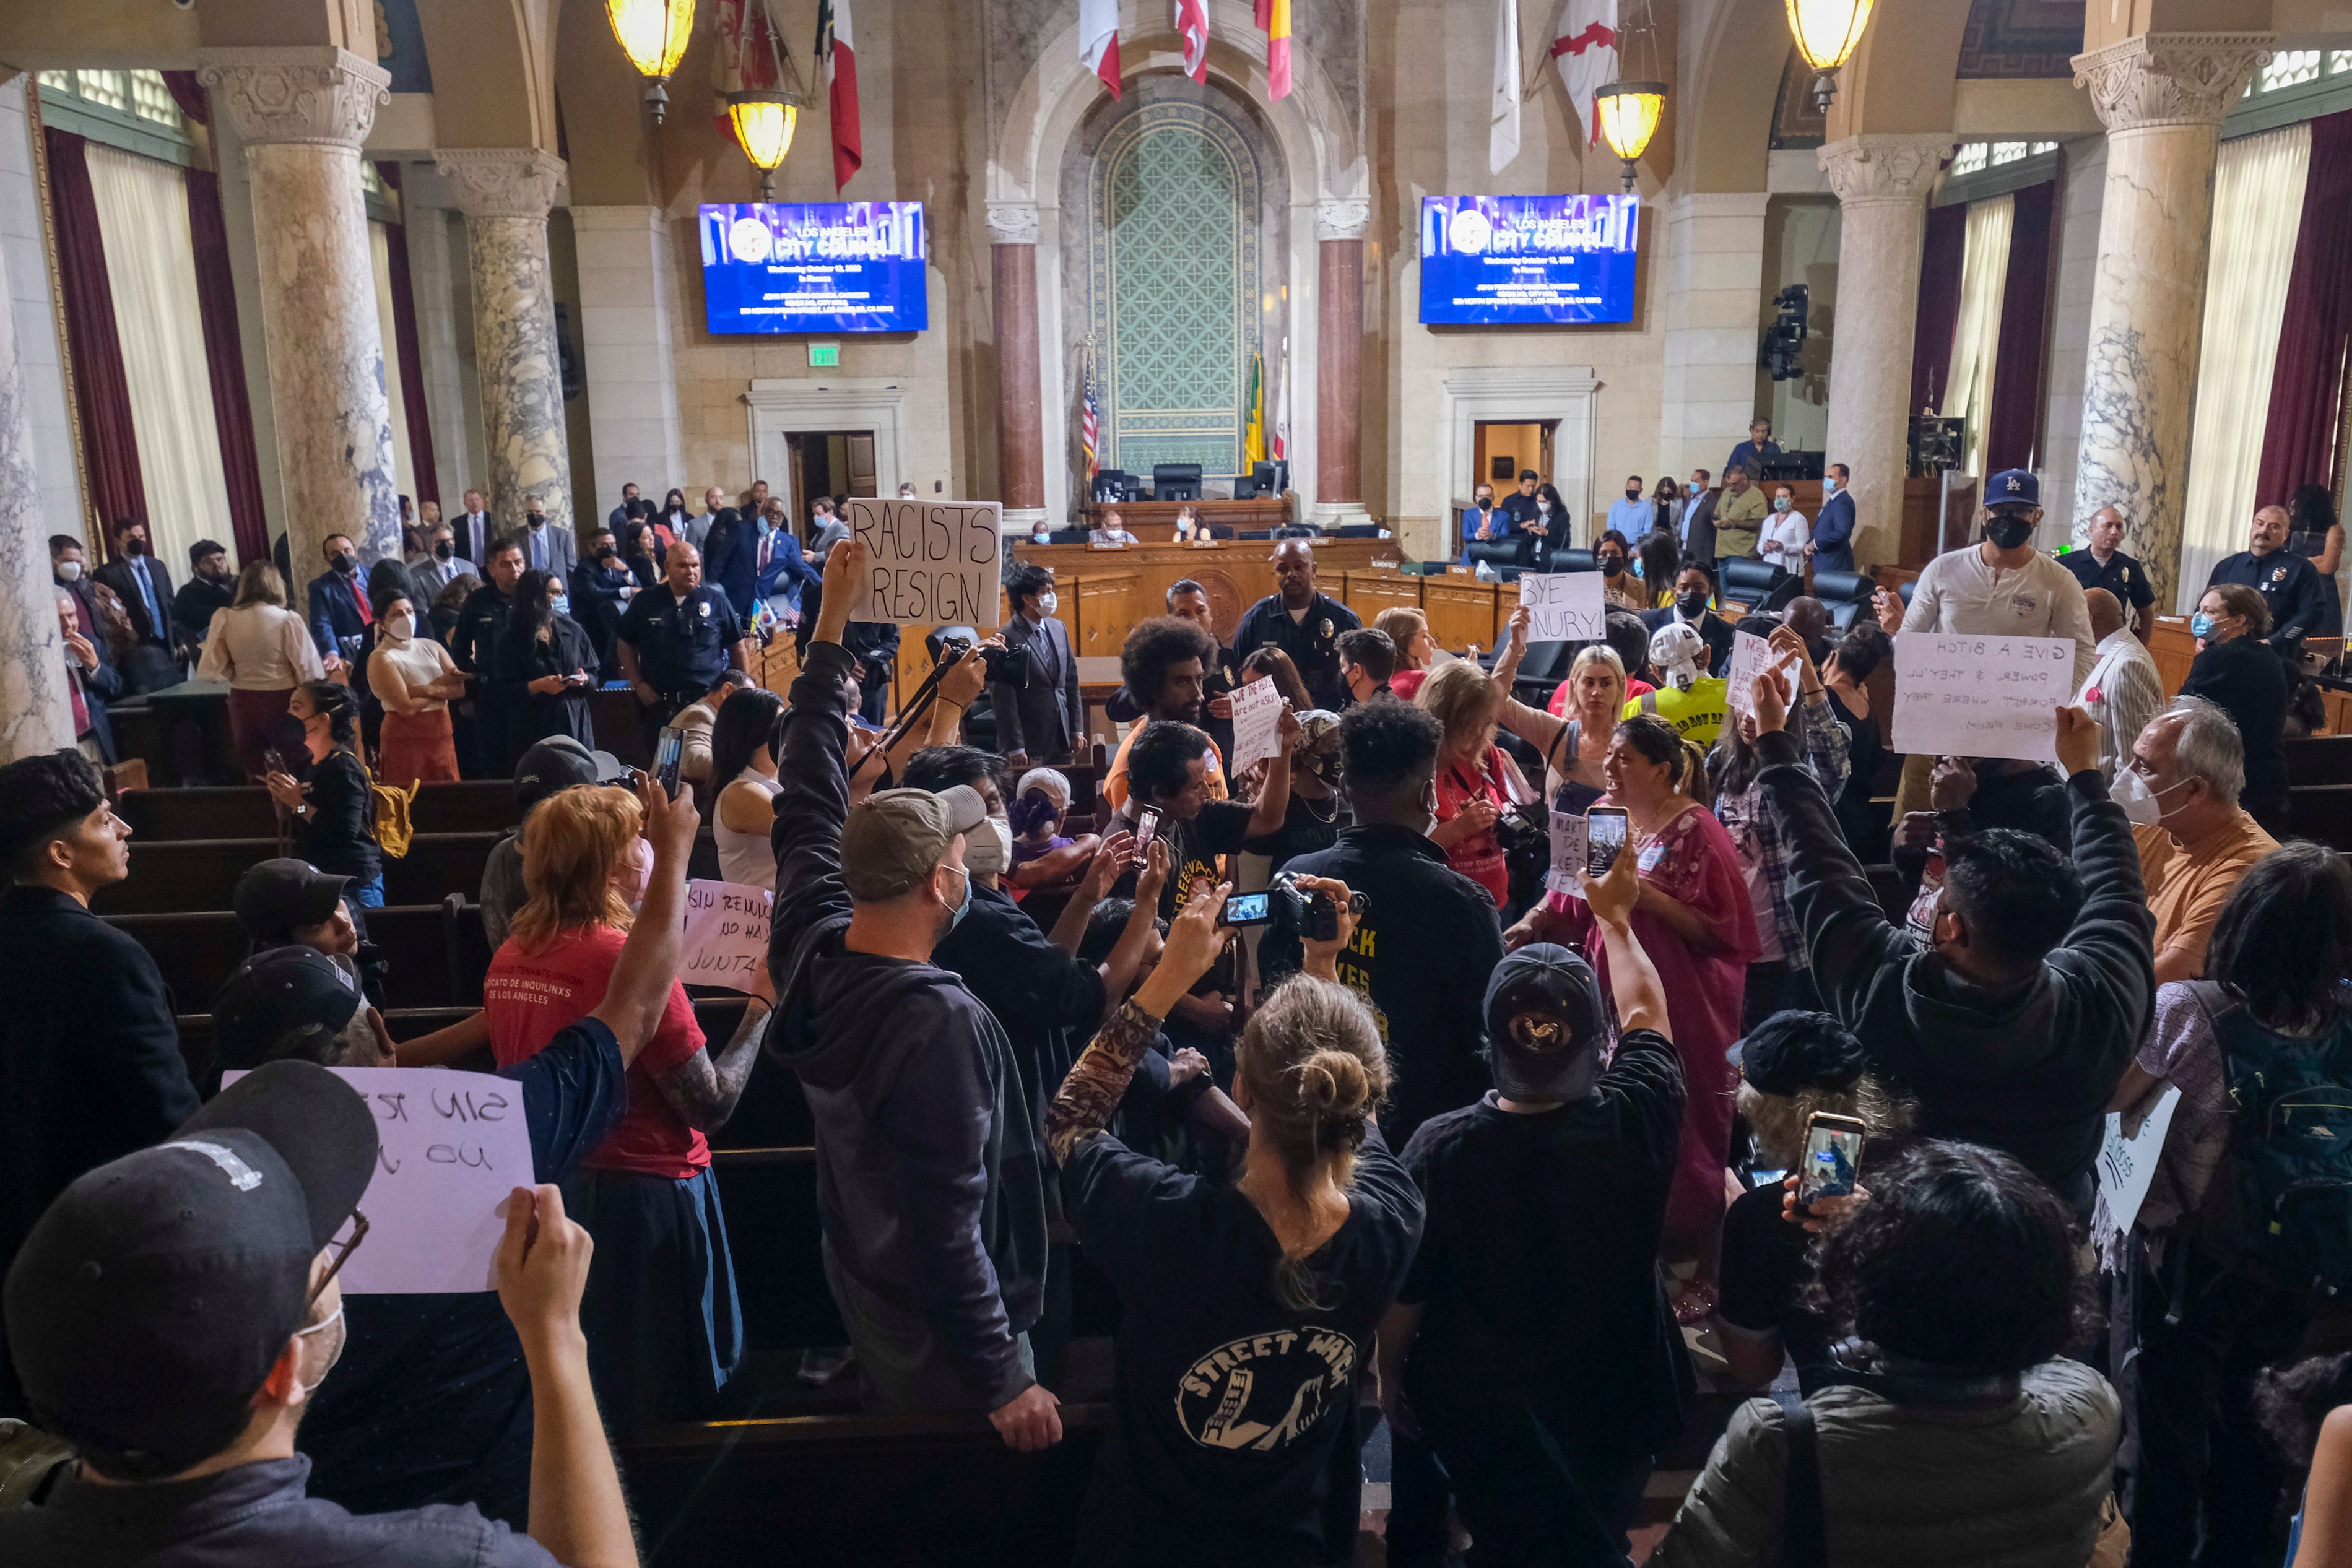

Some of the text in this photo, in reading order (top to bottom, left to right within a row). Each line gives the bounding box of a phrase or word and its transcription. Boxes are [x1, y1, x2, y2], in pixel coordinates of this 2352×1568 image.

[797, 227, 872, 238] LOS ANGELES
[1516, 219, 1586, 230] LOS ANGELES
[1493, 230, 1604, 247] CITY COUNCIL
[775, 239, 892, 256] CITY COUNCIL
[2007, 476, 2021, 490] LA
[853, 502, 996, 564] RACISTS
[872, 567, 981, 623] RESIGN
[1523, 576, 1566, 605] BYE
[1534, 610, 1603, 638] NURY!
[1231, 689, 1245, 704] WE
[1248, 683, 1257, 696] THE
[1234, 706, 1248, 716] are
[1248, 700, 1259, 712] not
[1556, 818, 1586, 834] MART
[1563, 836, 1580, 852] DE
[1454, 860, 1473, 868] STOP
[719, 922, 739, 937] NO
[688, 947, 757, 976] JUNTA
[517, 966, 550, 978] TENANTS
[553, 970, 584, 987] UNION
[489, 990, 496, 999] DE
[498, 990, 511, 1000] LOS
[510, 979, 519, 989] DE
[521, 980, 572, 998] INQUILINXS
[1184, 1332, 1298, 1398] STREET
